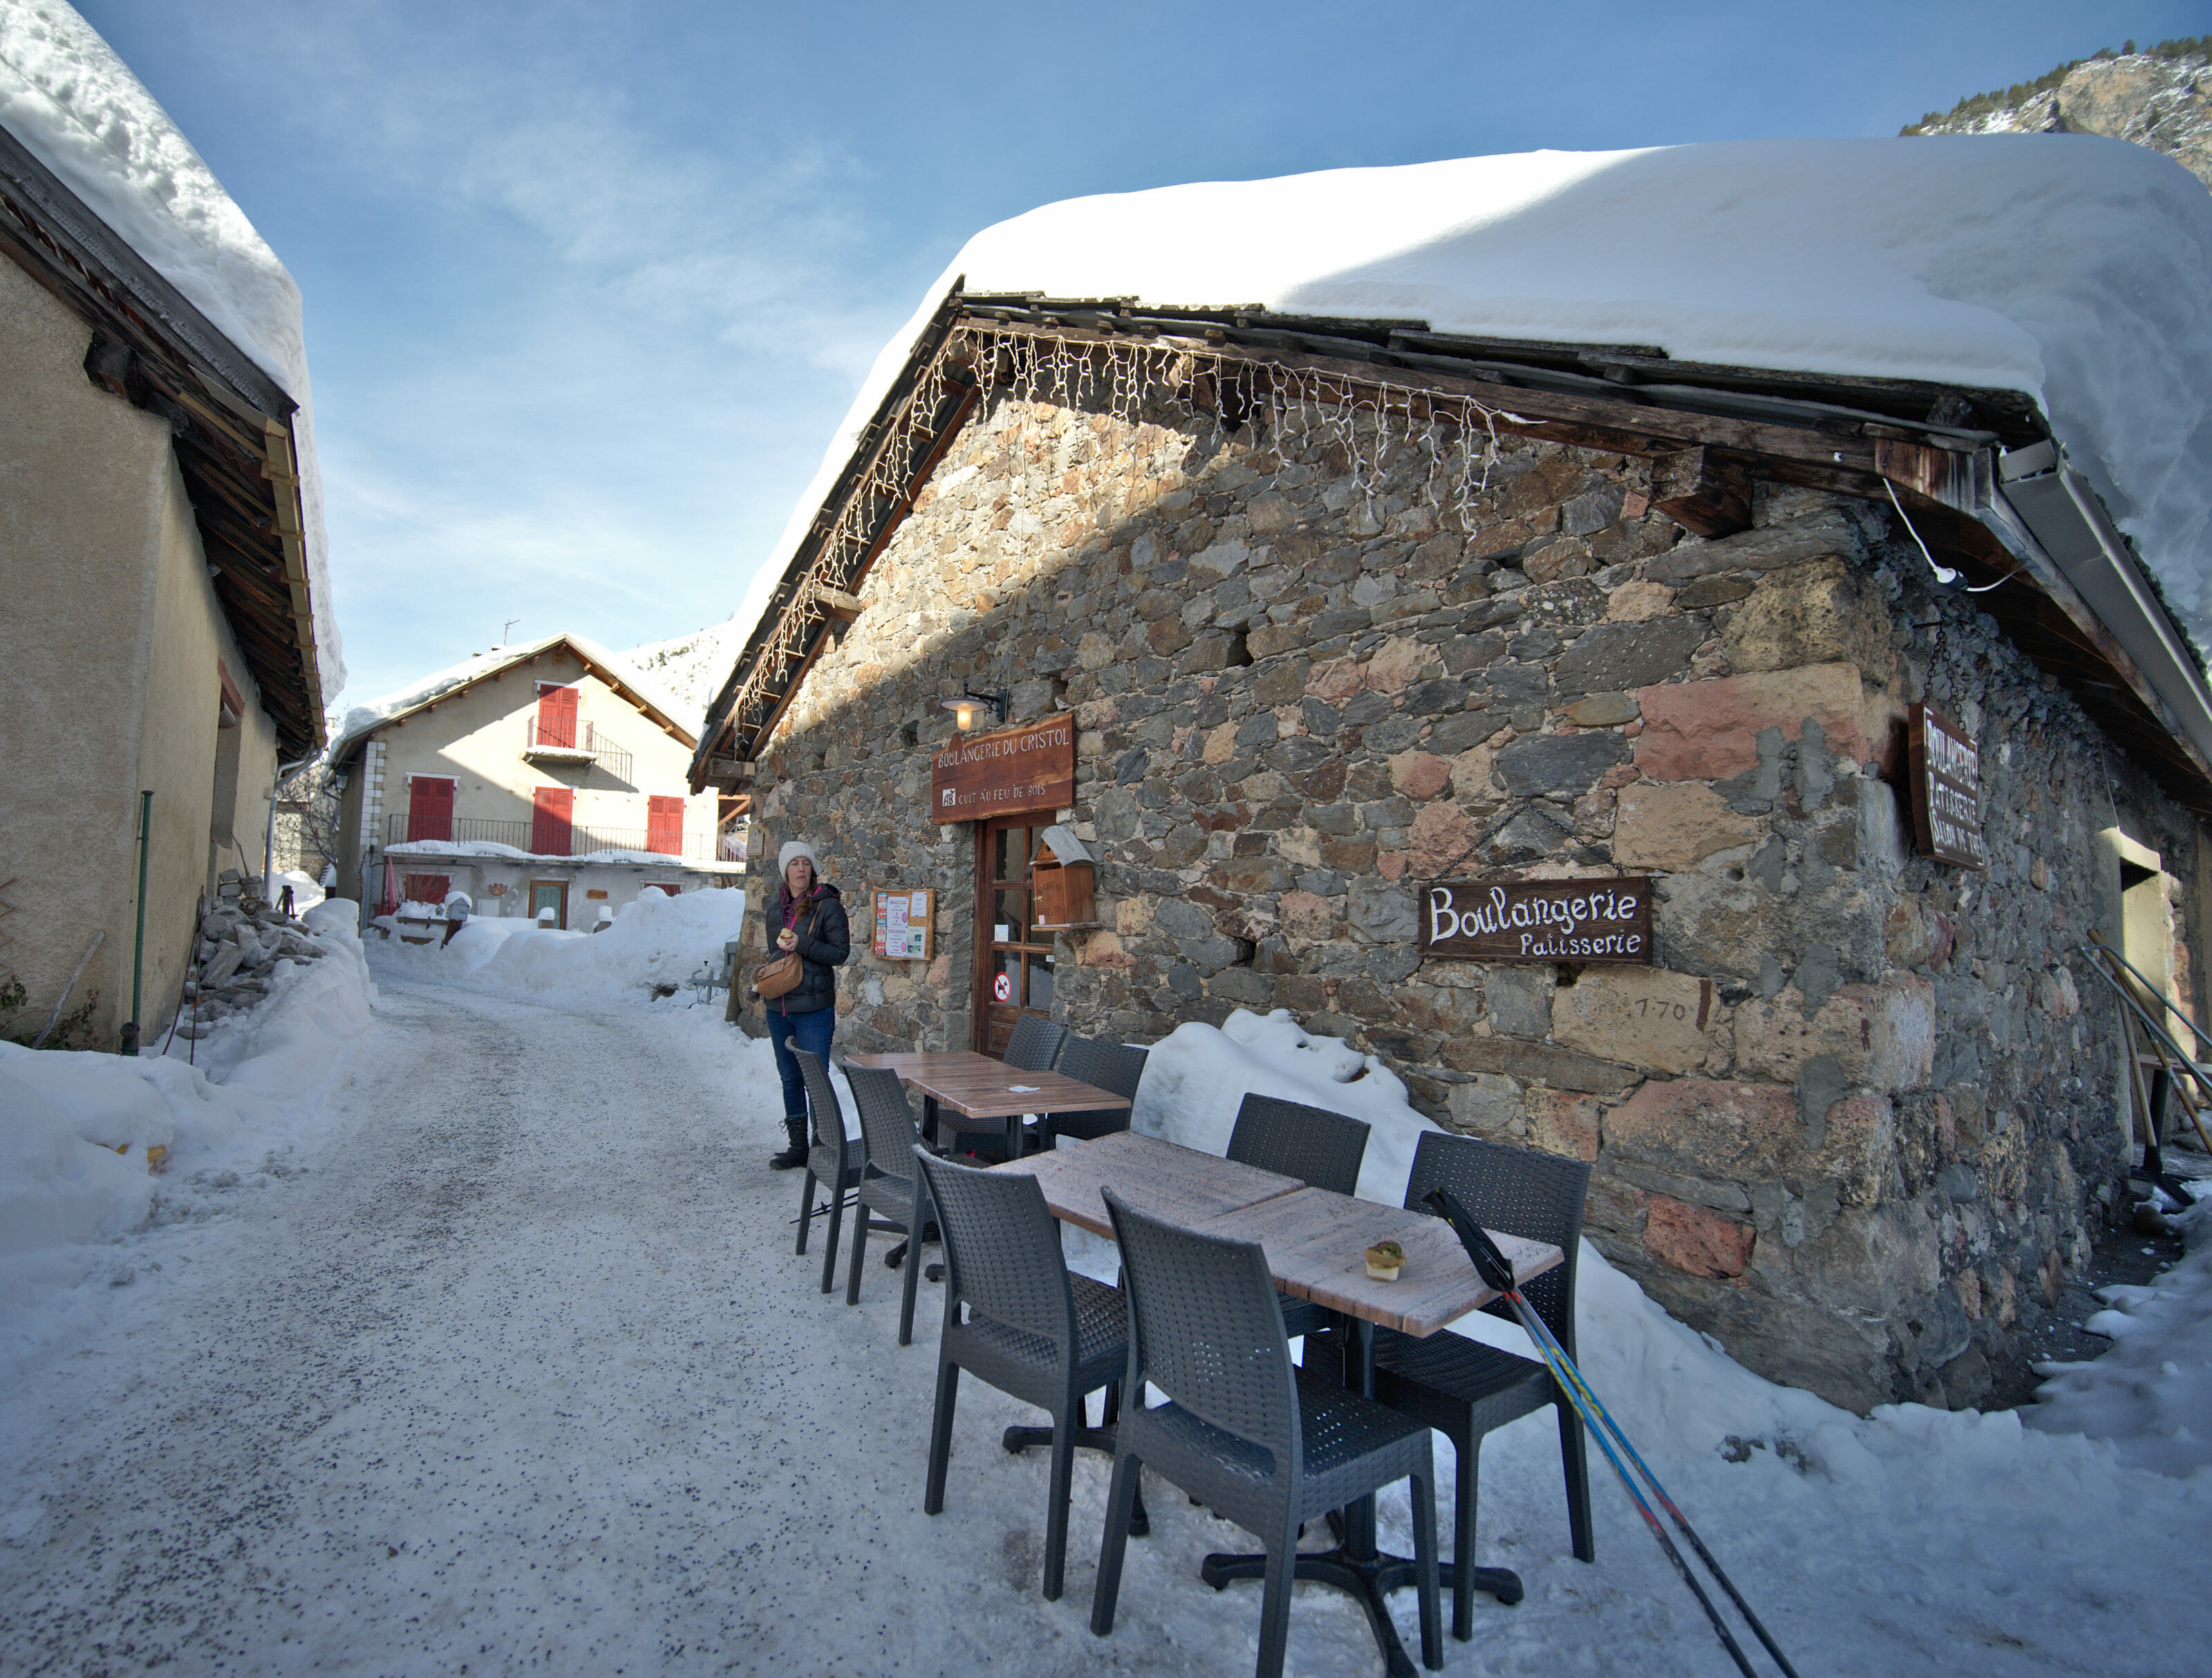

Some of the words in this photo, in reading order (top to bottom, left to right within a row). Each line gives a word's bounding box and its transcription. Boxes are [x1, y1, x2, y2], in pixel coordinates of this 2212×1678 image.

[938, 742, 1000, 768] BOULANGERIE
[1003, 737, 1017, 756] DU
[1020, 728, 1070, 752] CRISTOL
[1927, 719, 1977, 791] BOULANGERIE
[943, 793, 953, 805] AB
[959, 792, 977, 805] CUIT
[993, 789, 1010, 801] FEU
[1013, 786, 1024, 798] DE
[1028, 783, 1046, 796] BOIS
[1928, 771, 1977, 827] PATISSERIE
[1931, 808, 1957, 849] SALON
[1957, 826, 1967, 852] DE
[1430, 886, 1638, 946] Boulangerie
